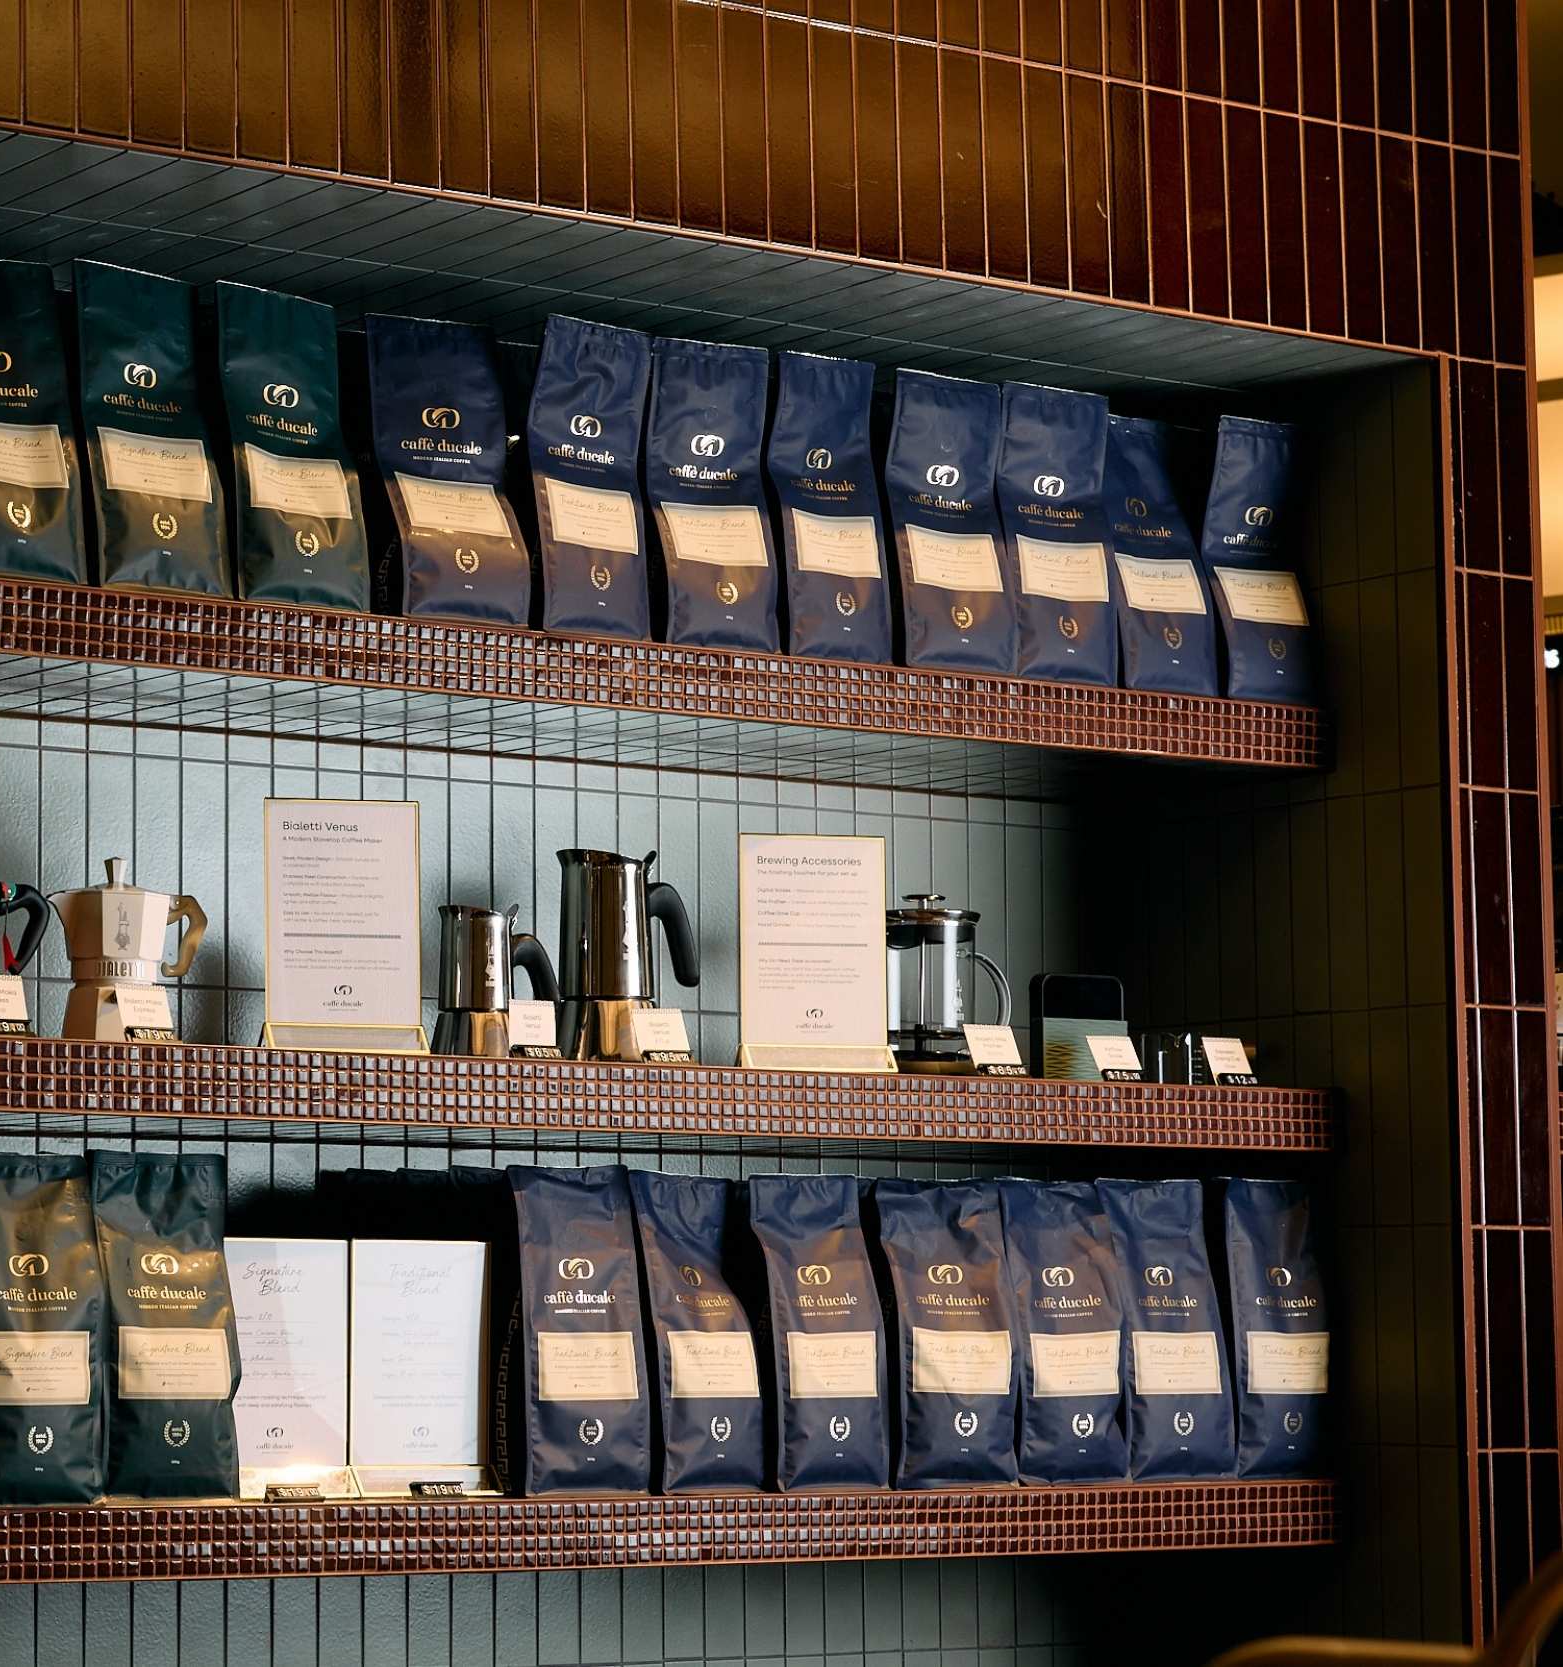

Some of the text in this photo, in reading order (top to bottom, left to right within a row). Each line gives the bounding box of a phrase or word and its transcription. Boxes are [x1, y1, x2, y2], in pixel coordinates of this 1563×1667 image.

[102, 391, 183, 415] caffè ducale
[245, 412, 319, 437] caffè ducale
[400, 437, 483, 456] caffè ducale
[547, 443, 615, 465] caffè ducale
[668, 464, 738, 481] caffè ducale
[815, 478, 856, 493] ducale
[933, 495, 973, 512] ducale
[1017, 503, 1085, 521] caffè ducale
[283, 821, 359, 832] Bialetti Venus
[757, 855, 862, 866] Brewing Accessories
[242, 1261, 303, 1282] Signature
[27, 1286, 78, 1302] ducale
[127, 1285, 207, 1300] caffè ducale
[258, 1277, 300, 1296] Blend
[543, 1289, 616, 1304] caffè ducale
[816, 1292, 858, 1307] ducale
[916, 1292, 990, 1307] caffè ducale
[1058, 1294, 1102, 1309] ducale
[1161, 1294, 1198, 1309] ducale
